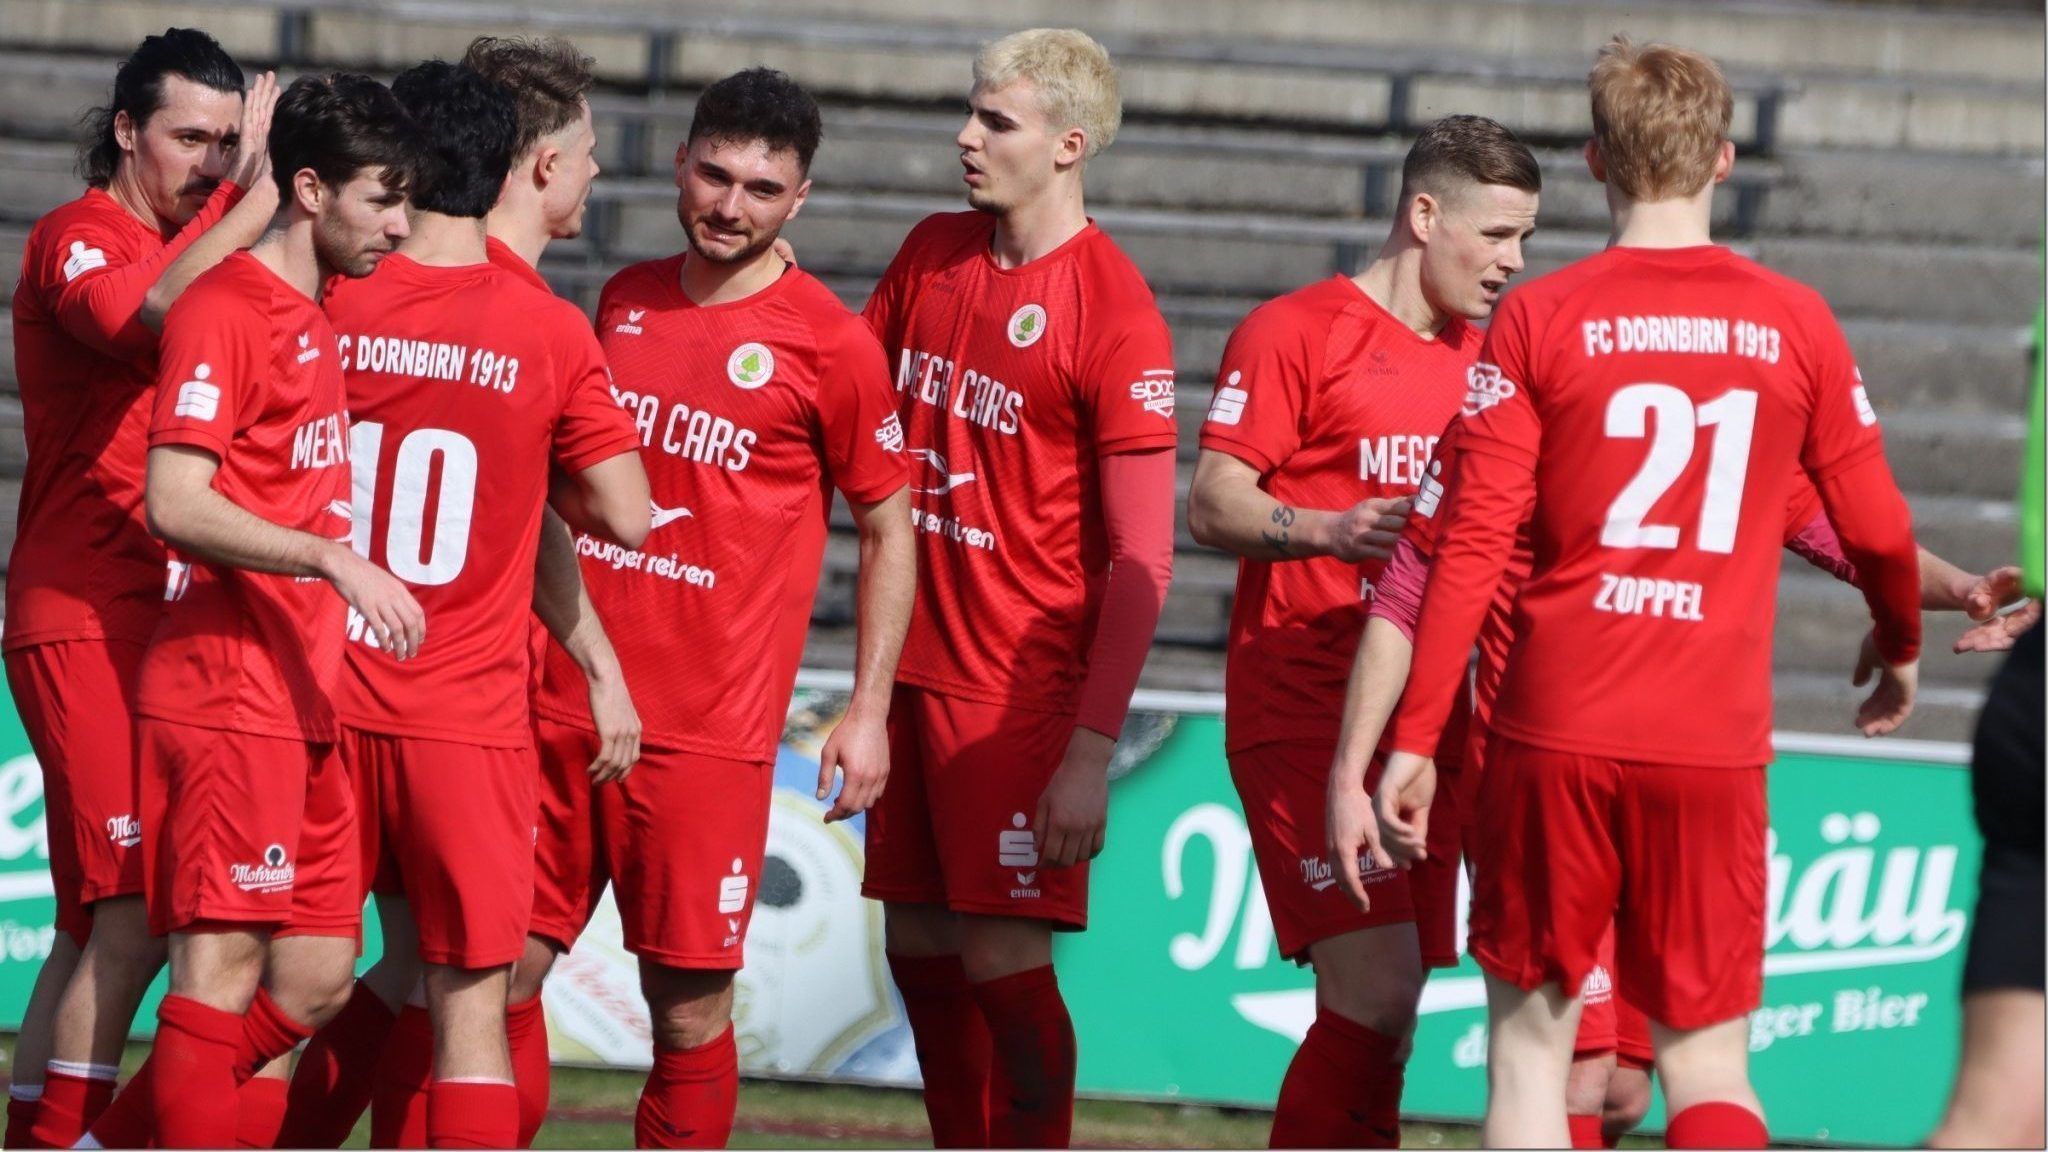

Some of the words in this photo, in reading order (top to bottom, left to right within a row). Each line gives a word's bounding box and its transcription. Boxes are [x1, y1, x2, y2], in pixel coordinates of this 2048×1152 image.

[356, 335, 466, 381] DORNBIRN
[470, 348, 518, 393] 1913
[1584, 320, 1613, 357] FC
[1616, 315, 1728, 354] DORNBIRN
[1734, 319, 1780, 364] 1913
[953, 369, 1023, 435] CARS
[662, 403, 757, 472] CARS
[1600, 383, 1758, 553] 21
[350, 420, 478, 586] 10
[646, 553, 715, 589] reisen
[1594, 574, 1704, 621] ZOPPEL
[1832, 986, 1928, 1033] Bier
